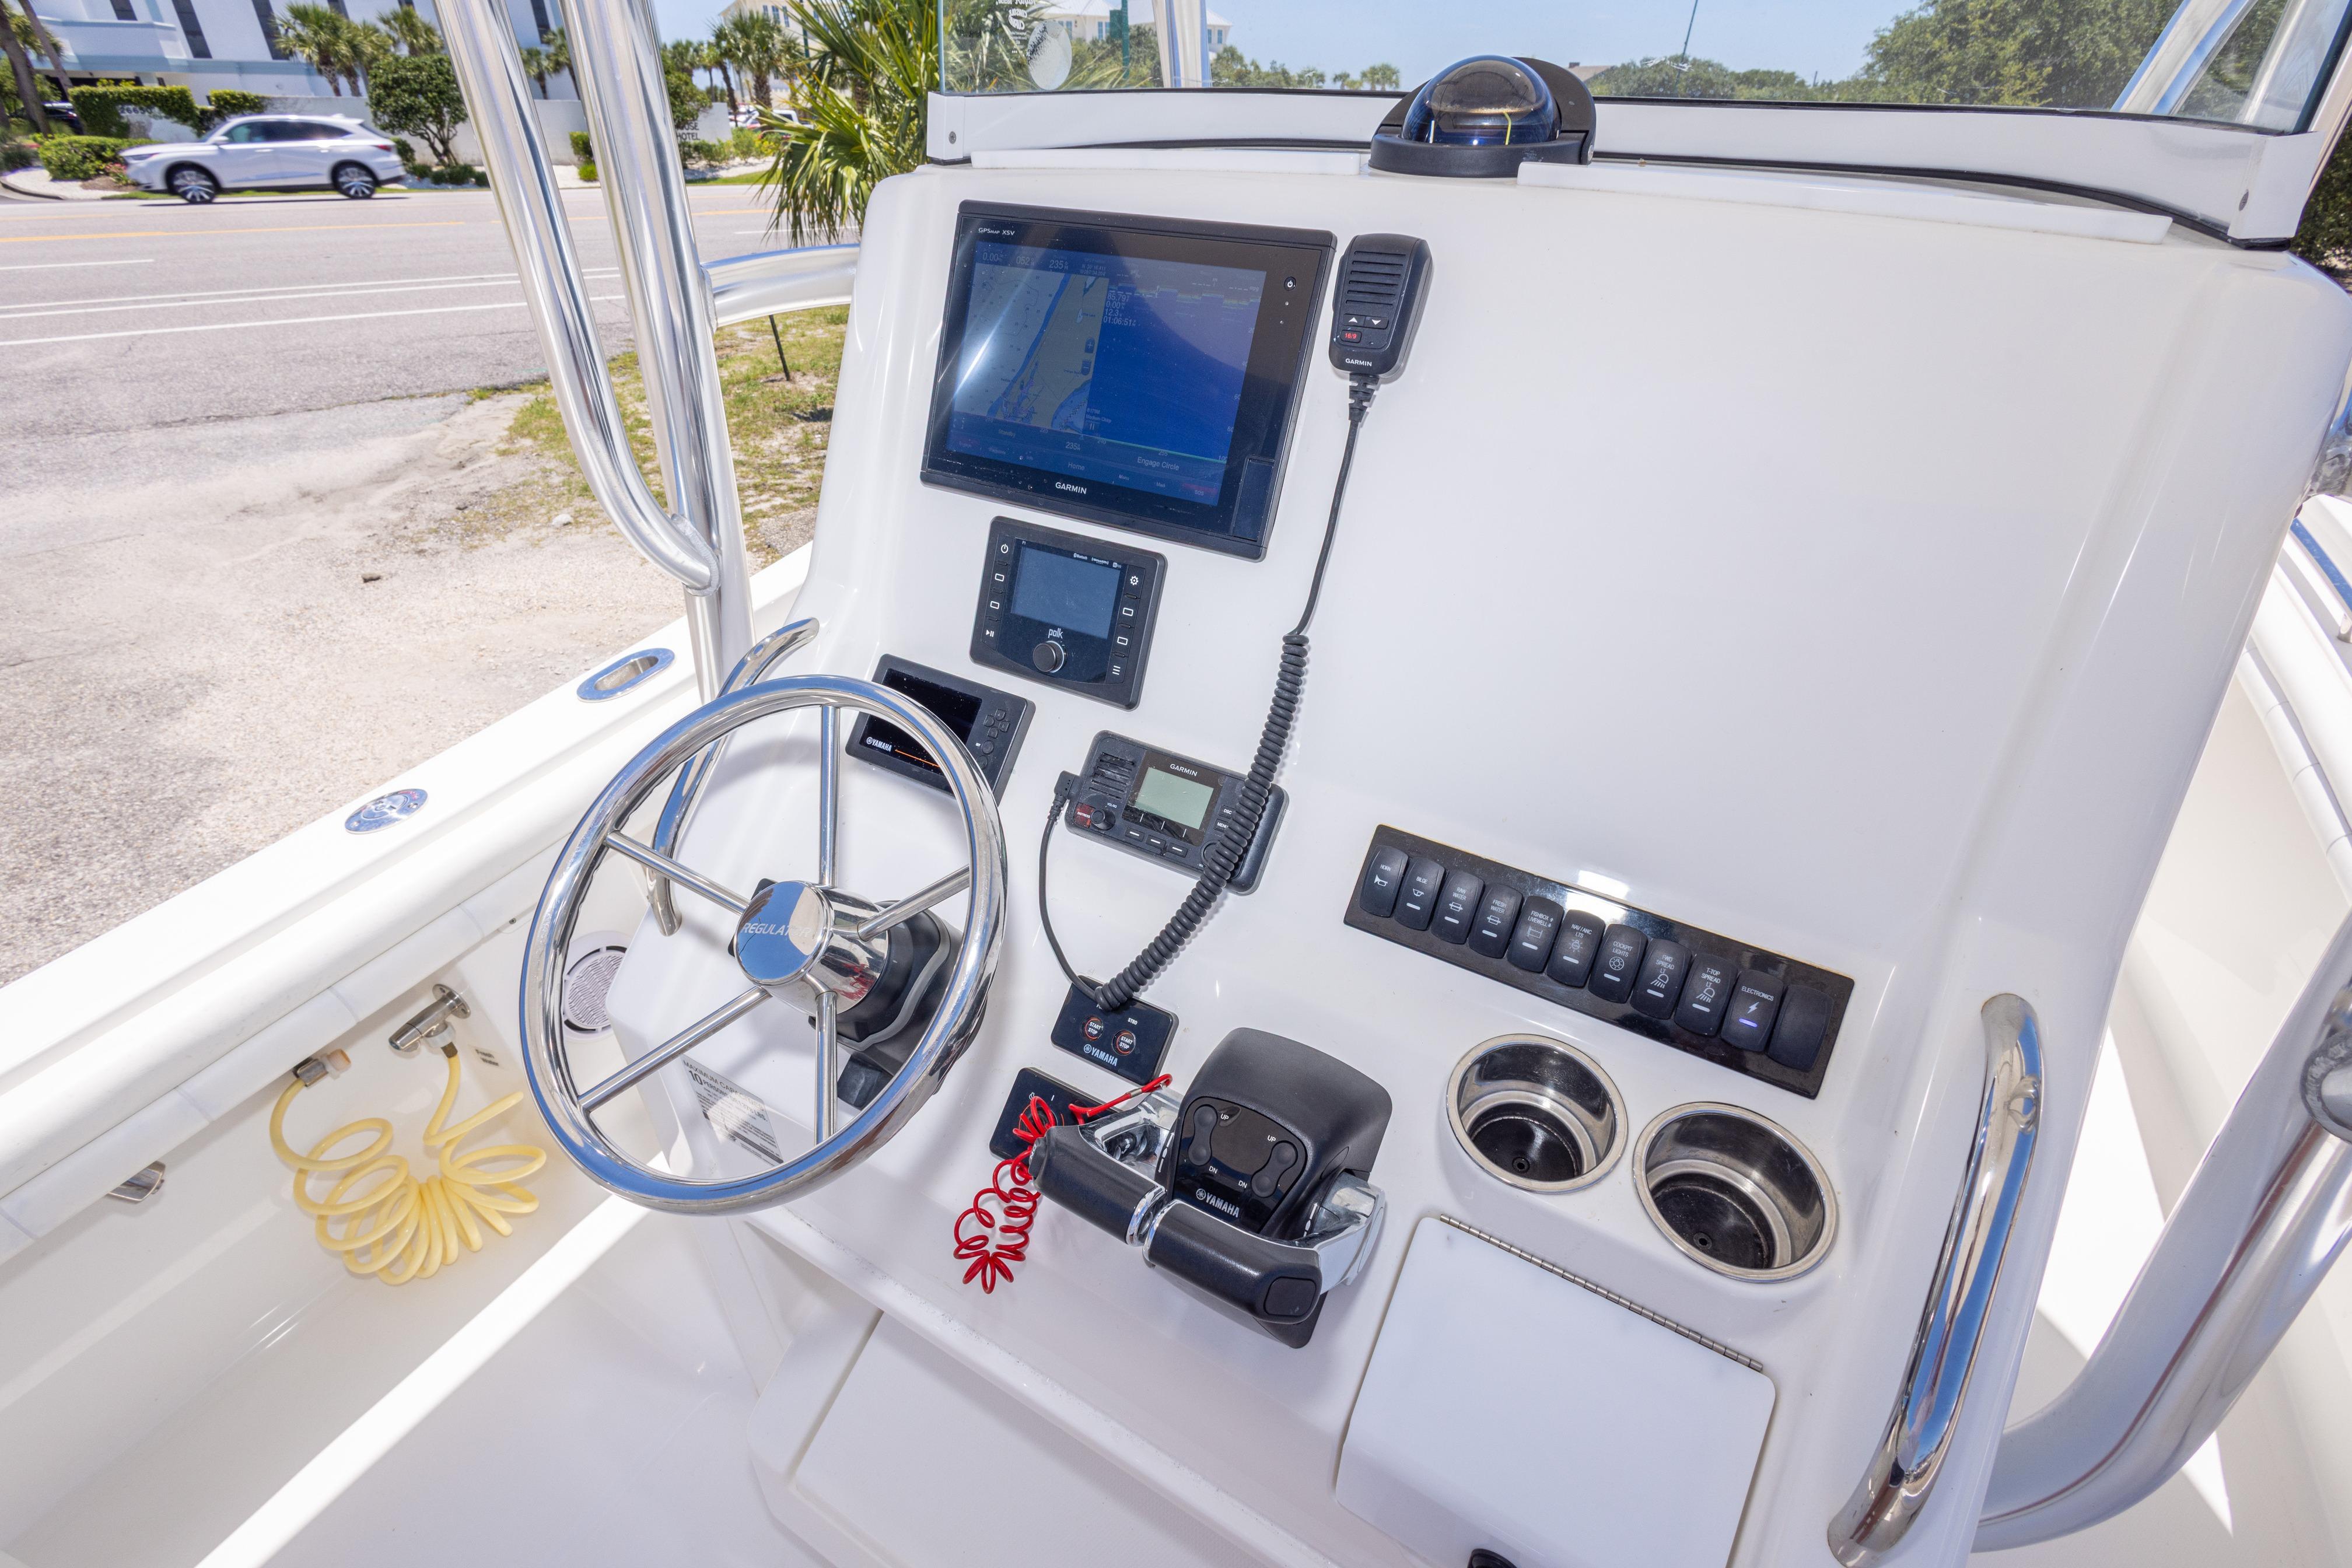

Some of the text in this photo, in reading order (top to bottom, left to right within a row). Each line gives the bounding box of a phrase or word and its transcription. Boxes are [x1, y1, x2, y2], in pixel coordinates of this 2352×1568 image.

[676, 132, 700, 141] HOTEL
[982, 252, 999, 262] 0.00
[1016, 256, 1030, 265] 052
[1049, 259, 1064, 270] 235
[1107, 293, 1126, 302] 85.79
[1106, 300, 1121, 309] 0.00
[1105, 308, 1119, 317] 12.3
[1103, 315, 1132, 327] 01:06:51
[1345, 358, 1372, 367] GARMIN
[998, 429, 1016, 438] Standby
[1065, 442, 1076, 450] 235
[1068, 462, 1086, 471] Home
[1138, 457, 1180, 471] Engage Circle
[1055, 481, 1087, 495] GARMIN
[1048, 628, 1063, 639] polk
[872, 737, 892, 752] YAMAHA
[1170, 763, 1198, 778] GARMIN
[1416, 876, 1428, 884] BILGE
[1452, 892, 1466, 901] WATER
[1492, 899, 1507, 908] FRESH
[1490, 905, 1506, 914] WATER
[1531, 910, 1549, 921] FISHBOX
[1527, 916, 1548, 927] LIVEWELL
[1613, 941, 1633, 951] COCKPIT
[1612, 948, 1629, 957] LIGHTS
[1656, 960, 1675, 970] SPREAD
[1706, 968, 1720, 976] T-TOP
[1701, 973, 1721, 984] SPREAD
[1741, 986, 1774, 1002] ELECTRONICS
[1089, 1021, 1101, 1030] START
[1127, 1017, 1138, 1026] STBD
[1121, 1036, 1133, 1045] START
[475, 1049, 495, 1059] Fresh
[1091, 1047, 1118, 1067] YAMAHA
[480, 1057, 499, 1067] Water
[683, 1060, 719, 1084] MAXIMUM
[688, 1070, 704, 1086] 10
[754, 1110, 768, 1122] LBS.
[1267, 1134, 1276, 1142] UP
[1209, 1166, 1217, 1174] DN
[1238, 1180, 1247, 1188] DN
[1205, 1192, 1240, 1218] YAMAHA
